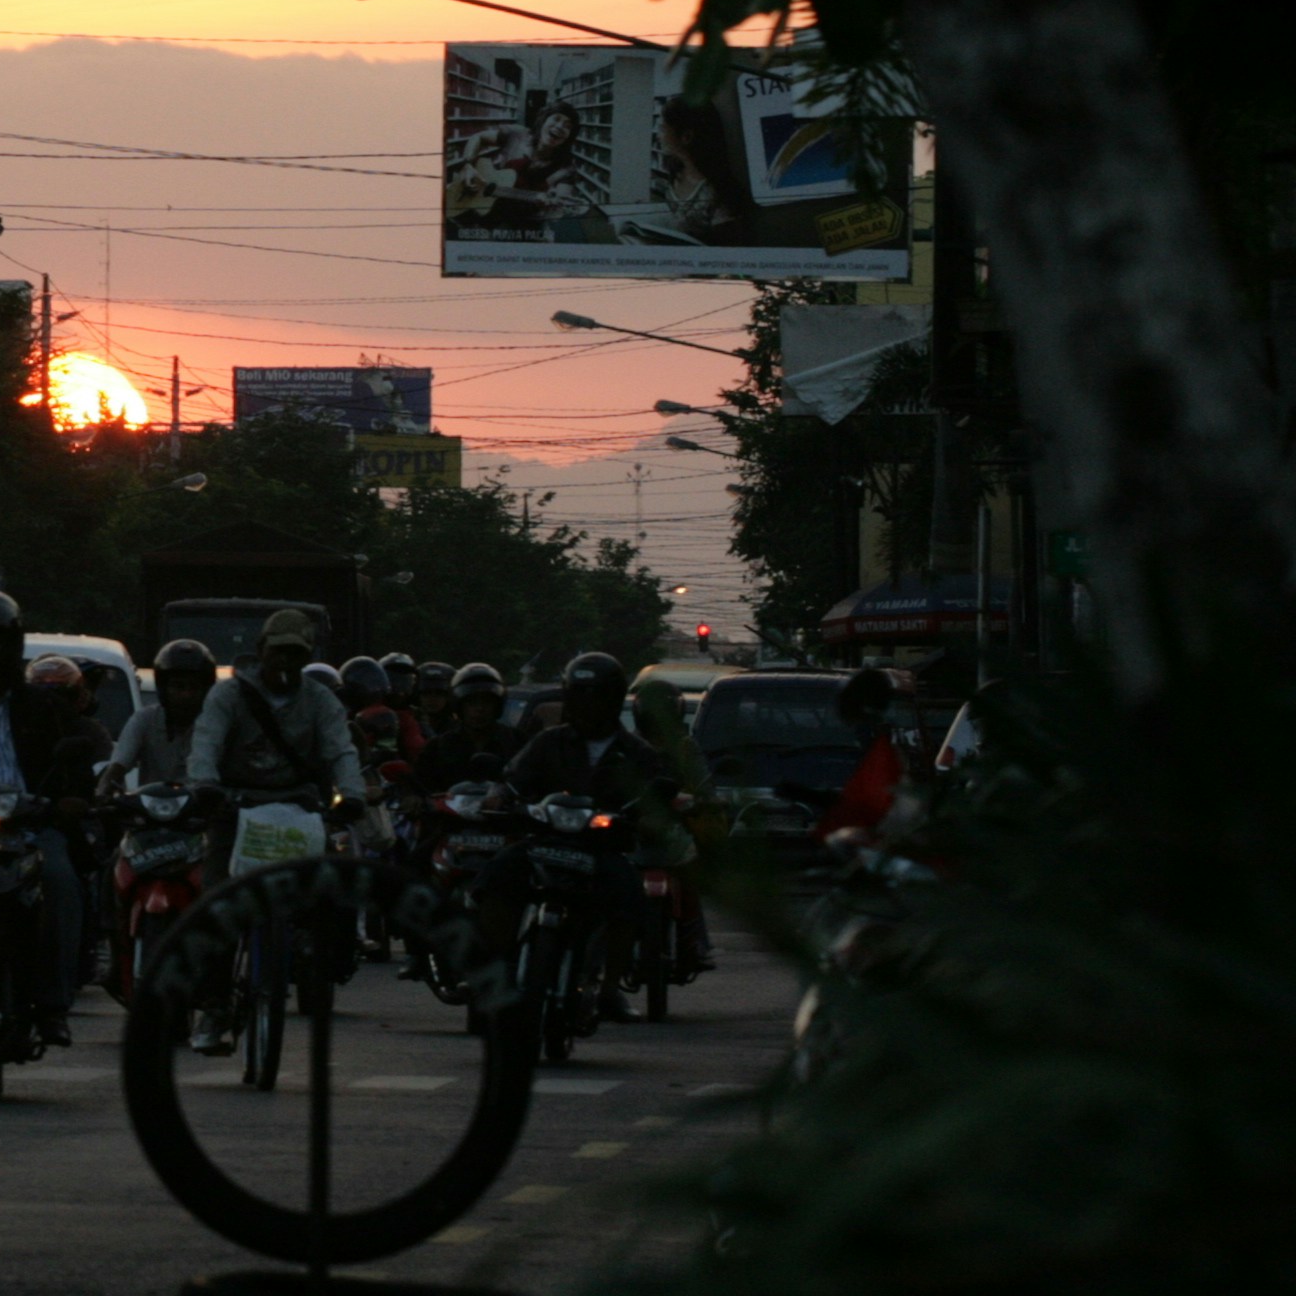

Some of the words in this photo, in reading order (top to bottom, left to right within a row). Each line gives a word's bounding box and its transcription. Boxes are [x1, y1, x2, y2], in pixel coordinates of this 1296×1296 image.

[294, 369, 353, 383] sekarang
[874, 598, 928, 610] YAMAHA
[900, 619, 928, 632] SAKTI
